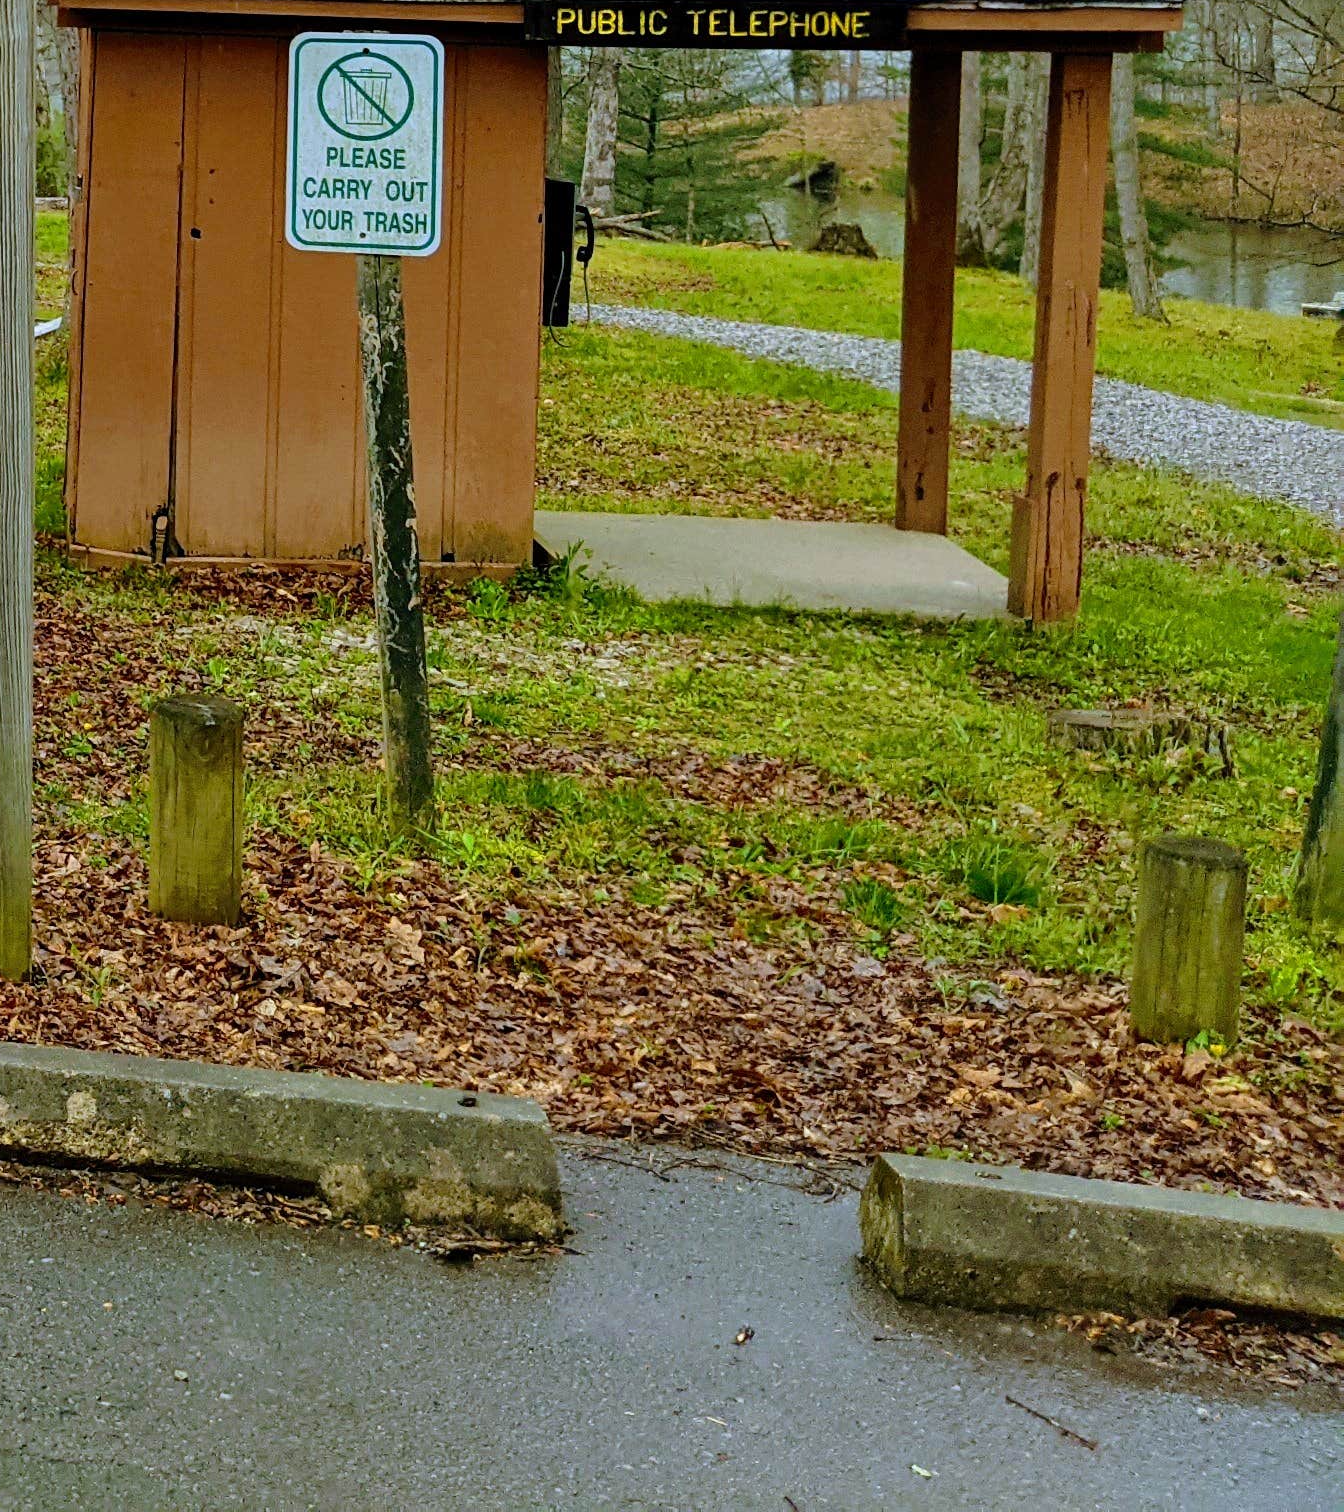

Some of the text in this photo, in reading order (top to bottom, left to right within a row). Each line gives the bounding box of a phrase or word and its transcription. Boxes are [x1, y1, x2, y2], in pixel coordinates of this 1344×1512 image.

[556, 8, 871, 38] PUBLIC TELEPHONE
[326, 146, 406, 170] PLEASE
[303, 177, 428, 203] CARRY OUT
[302, 209, 428, 234] YOUR TRASH
